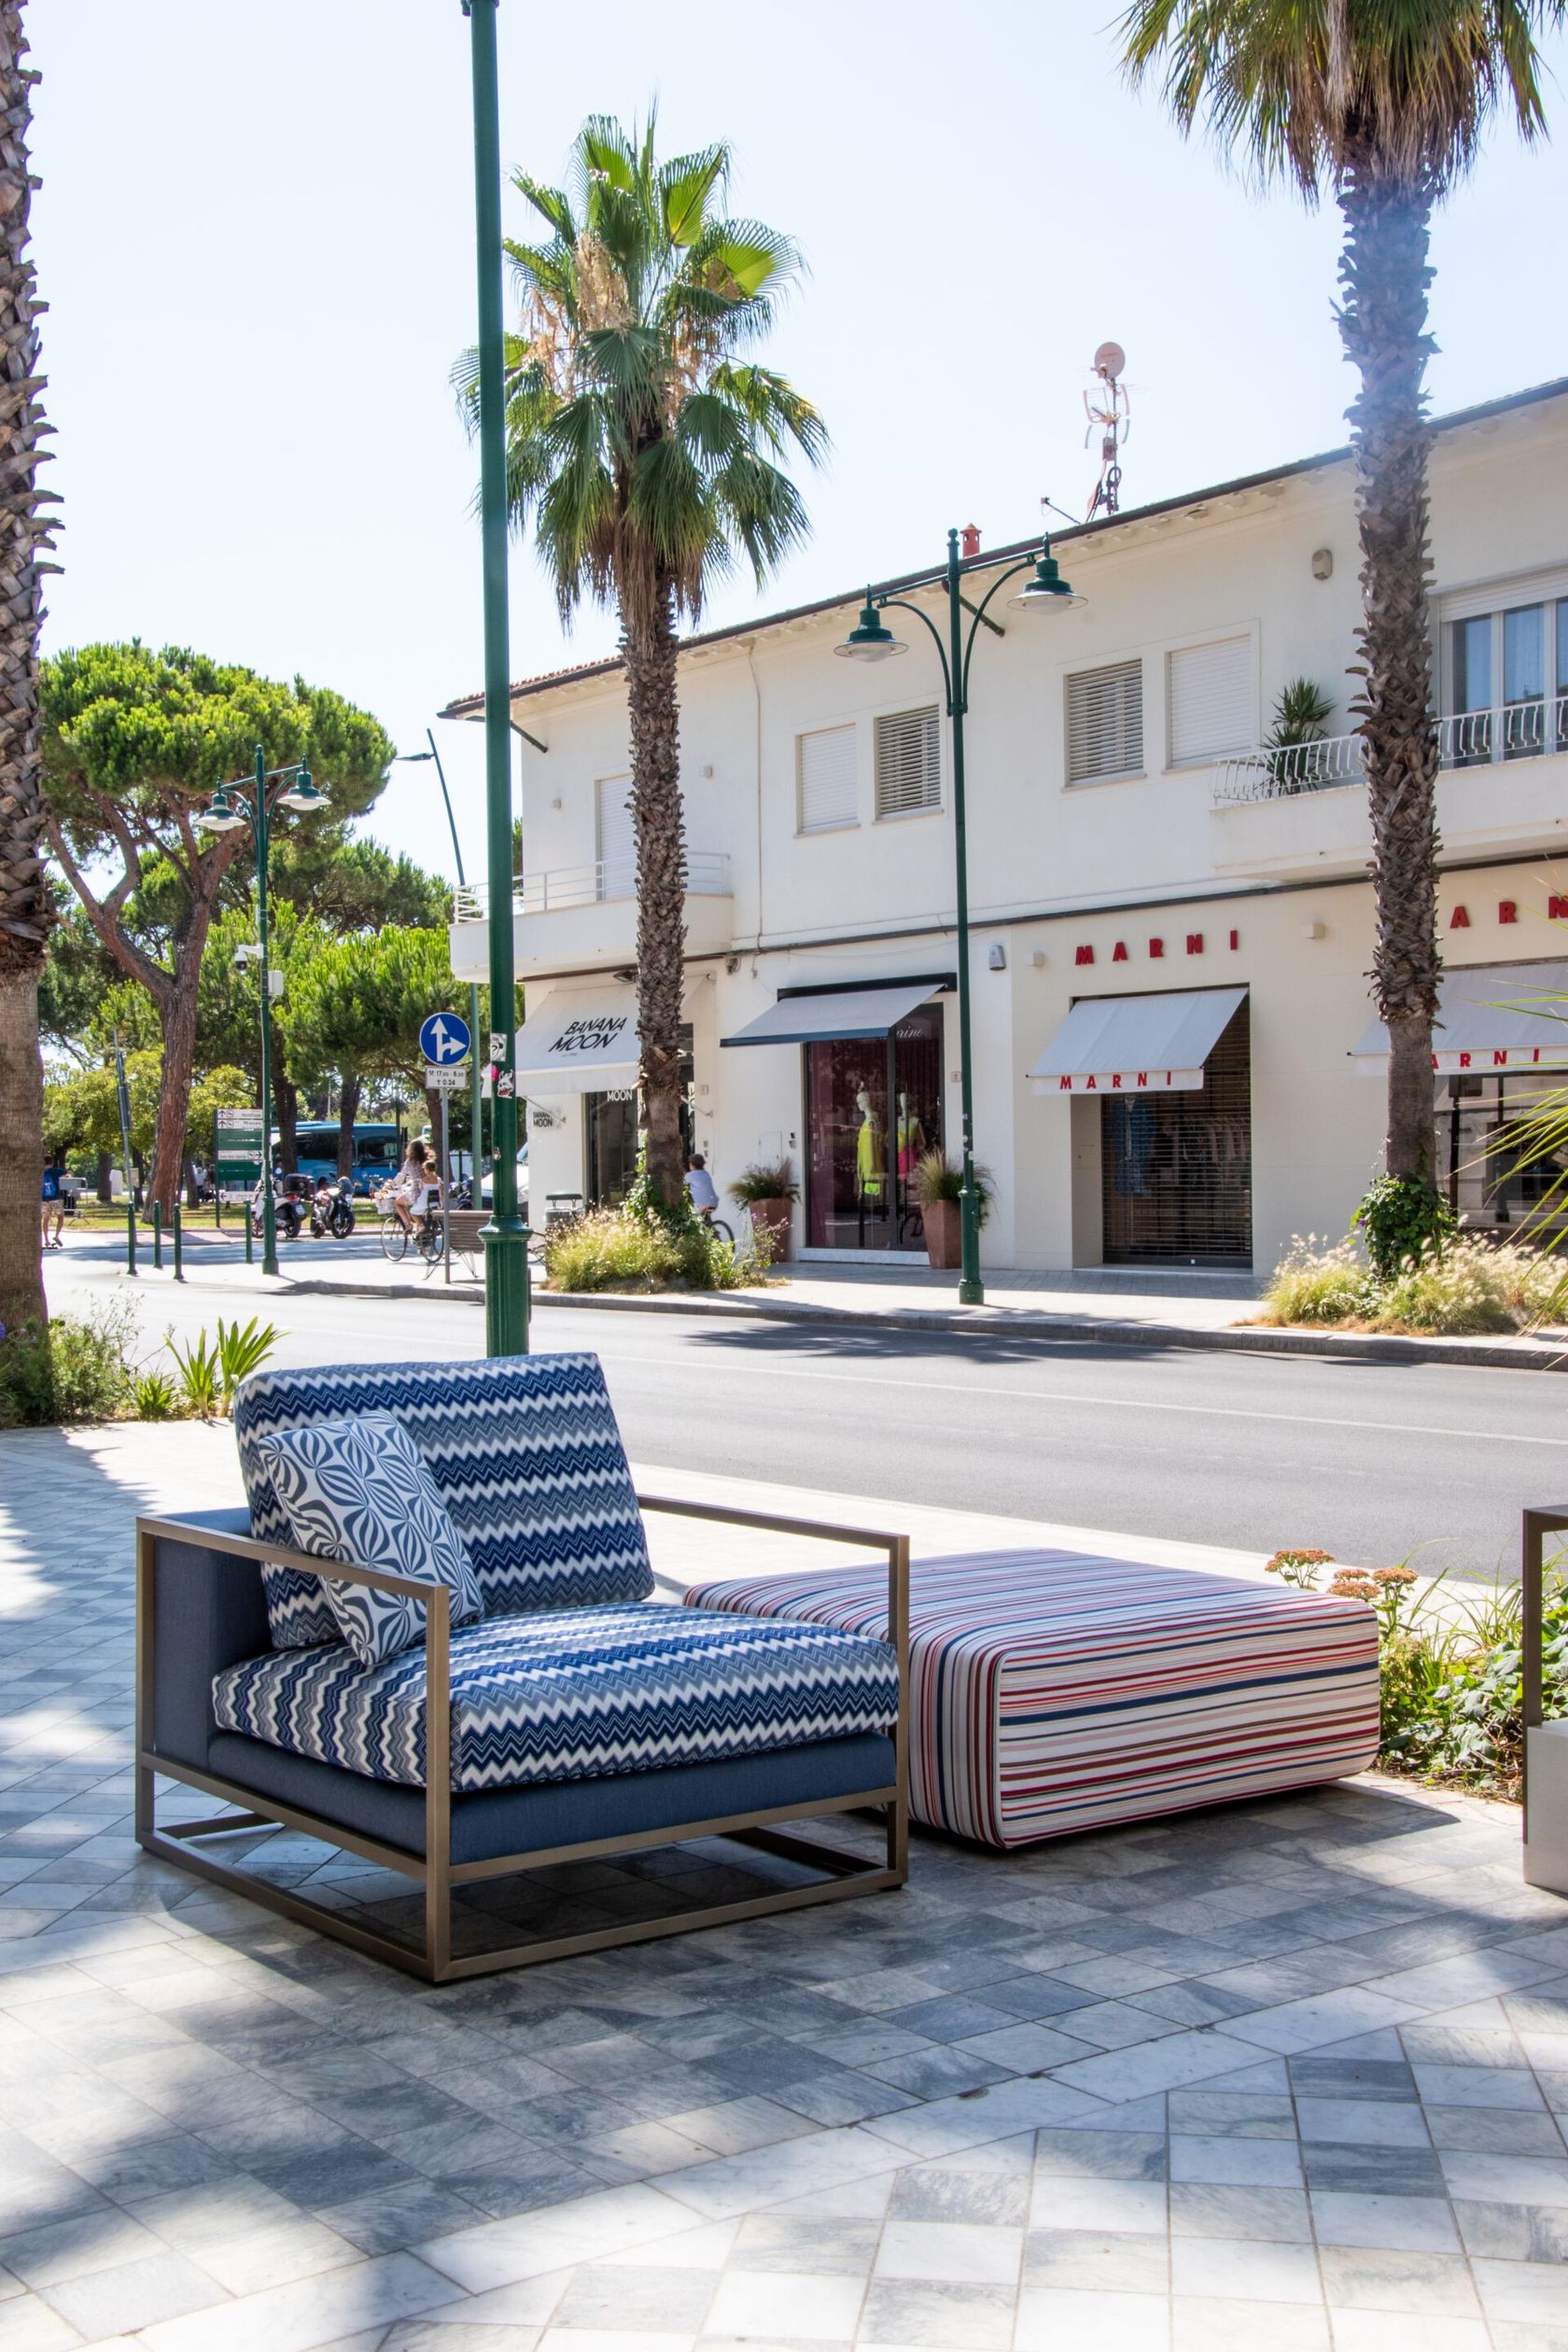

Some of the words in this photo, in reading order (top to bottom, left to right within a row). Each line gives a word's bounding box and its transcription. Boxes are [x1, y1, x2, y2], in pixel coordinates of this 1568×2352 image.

[1449, 896, 1568, 929] ARN
[1075, 930, 1239, 965] MARNI
[564, 1016, 628, 1035] BANANA
[547, 1032, 618, 1053] MOON
[1059, 1071, 1171, 1090] MARNI
[607, 1090, 633, 1101] MOON
[533, 1118, 553, 1127] MOON
